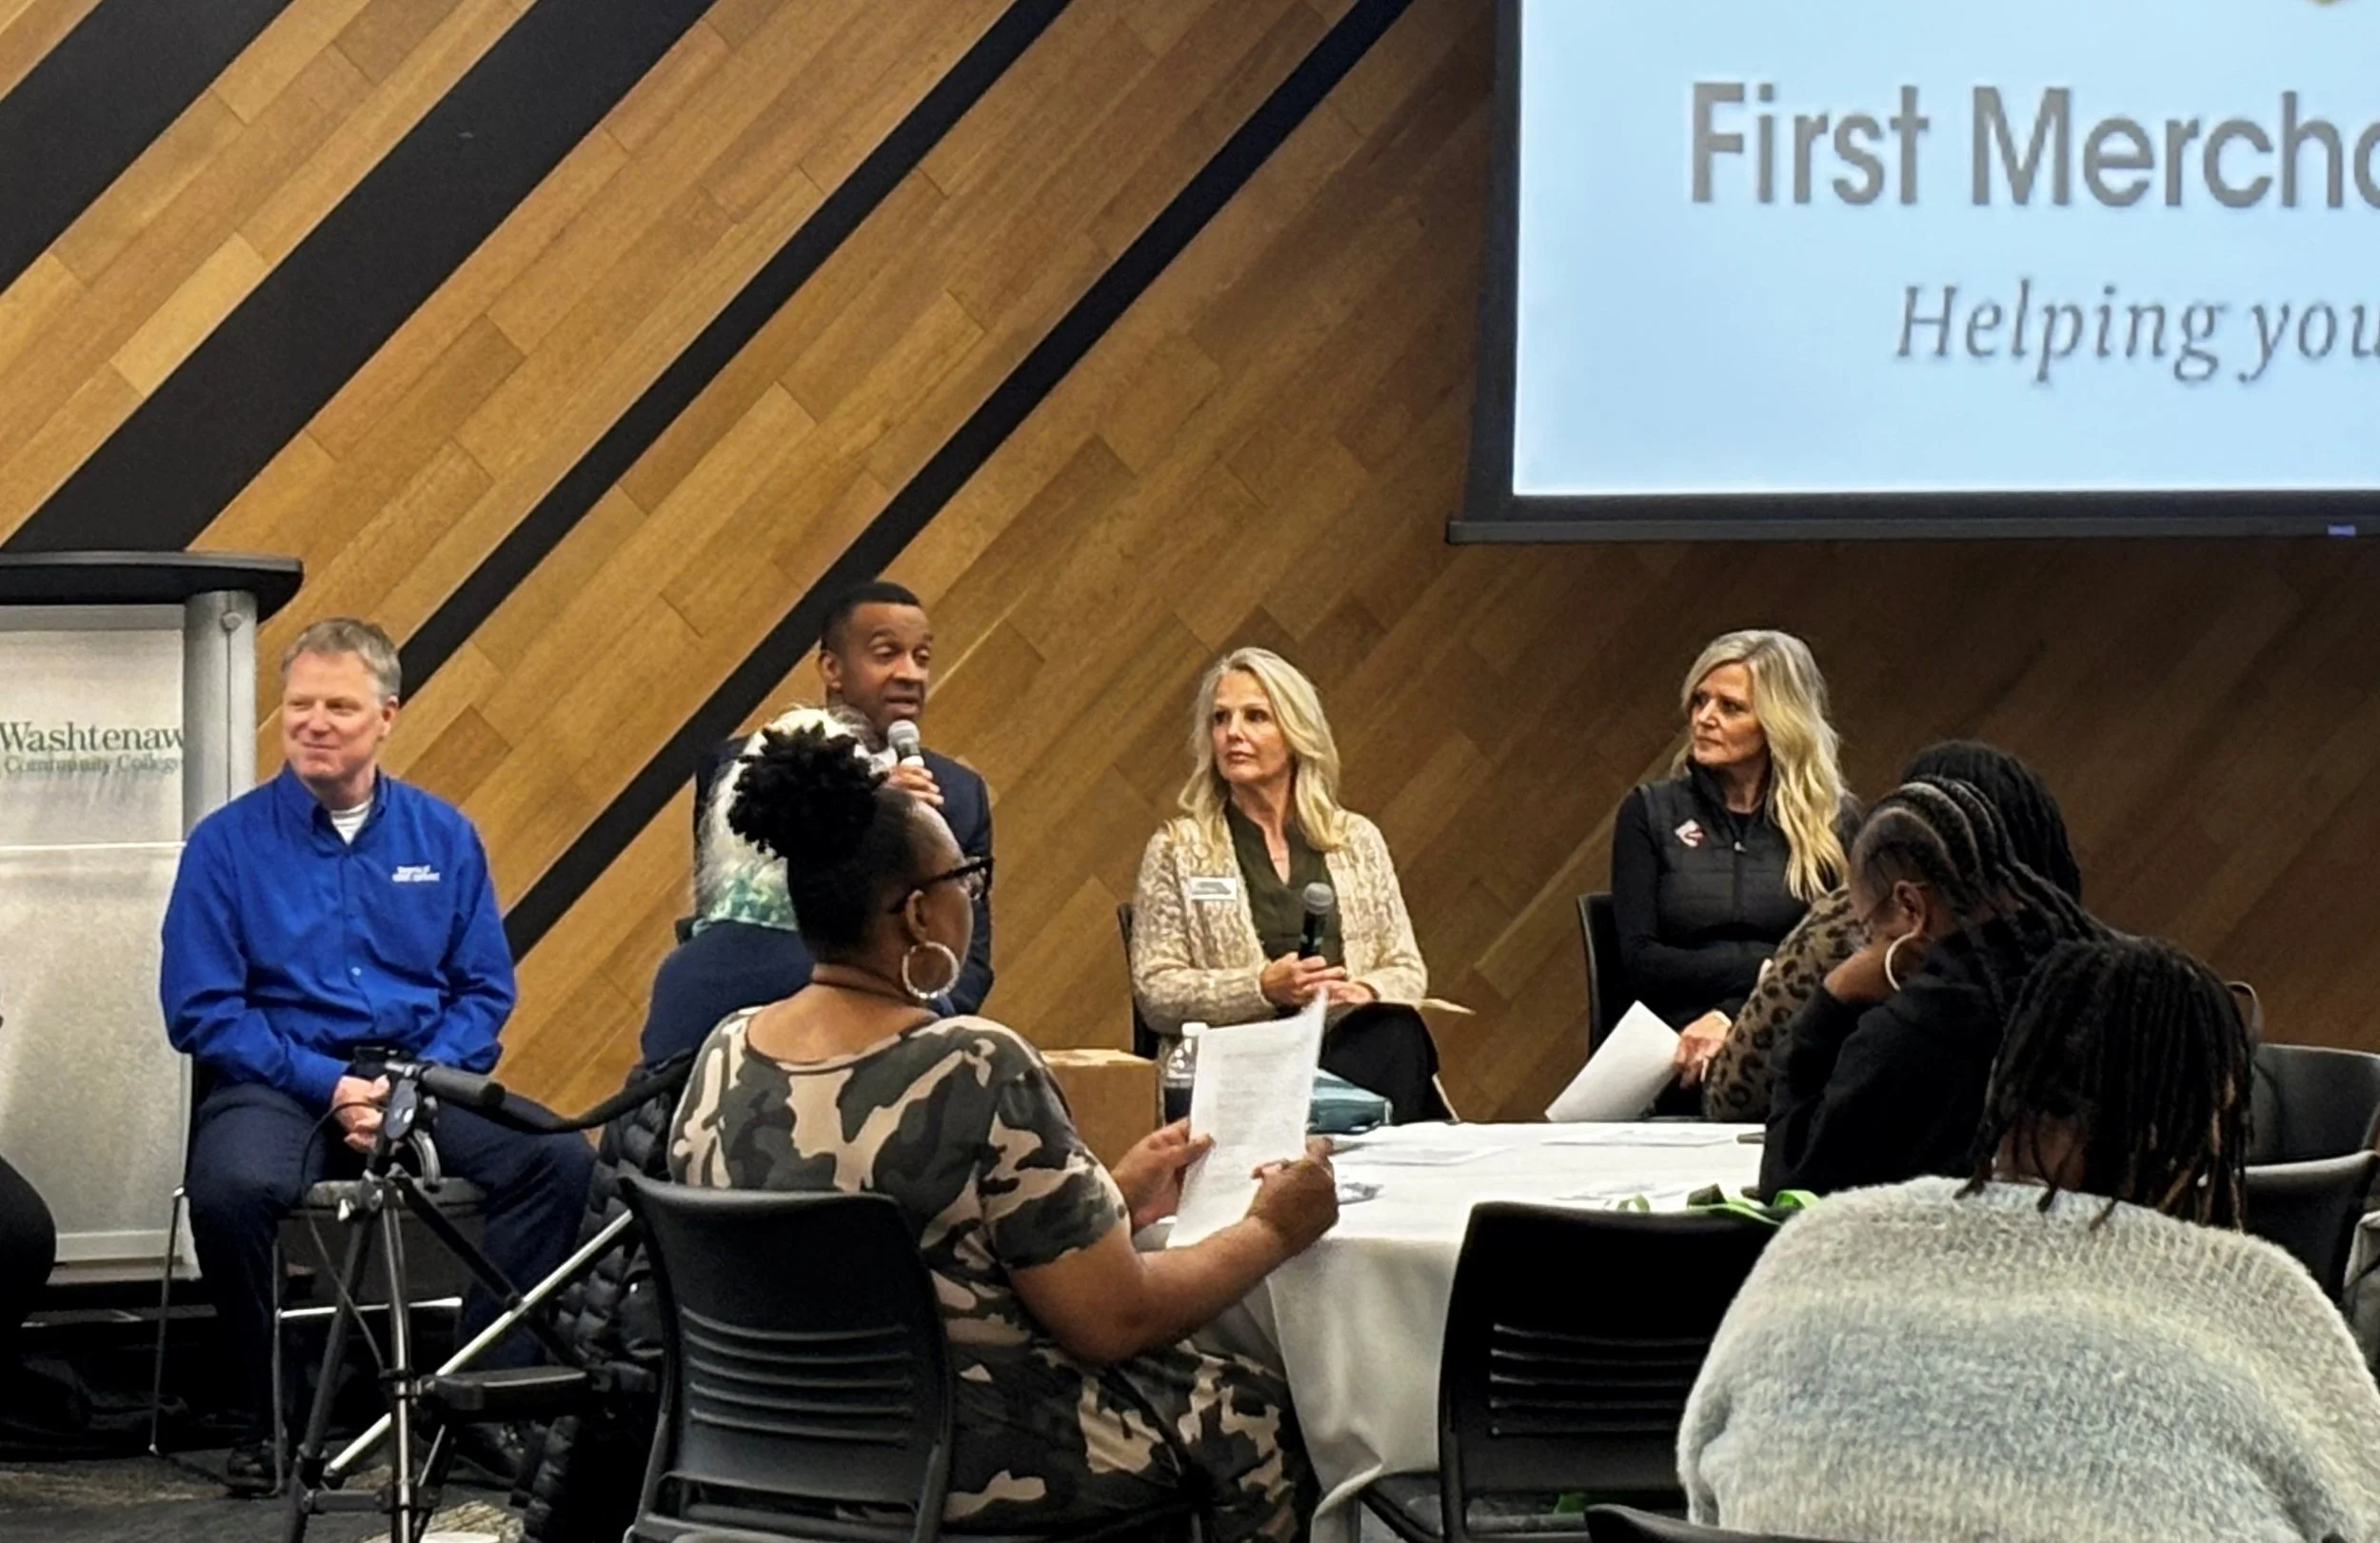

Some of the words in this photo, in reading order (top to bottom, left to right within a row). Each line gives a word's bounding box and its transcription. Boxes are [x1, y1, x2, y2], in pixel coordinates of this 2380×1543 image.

[1691, 81, 1930, 206] First
[1896, 279, 2227, 384] Helping
[0, 721, 184, 752] Washtenaw
